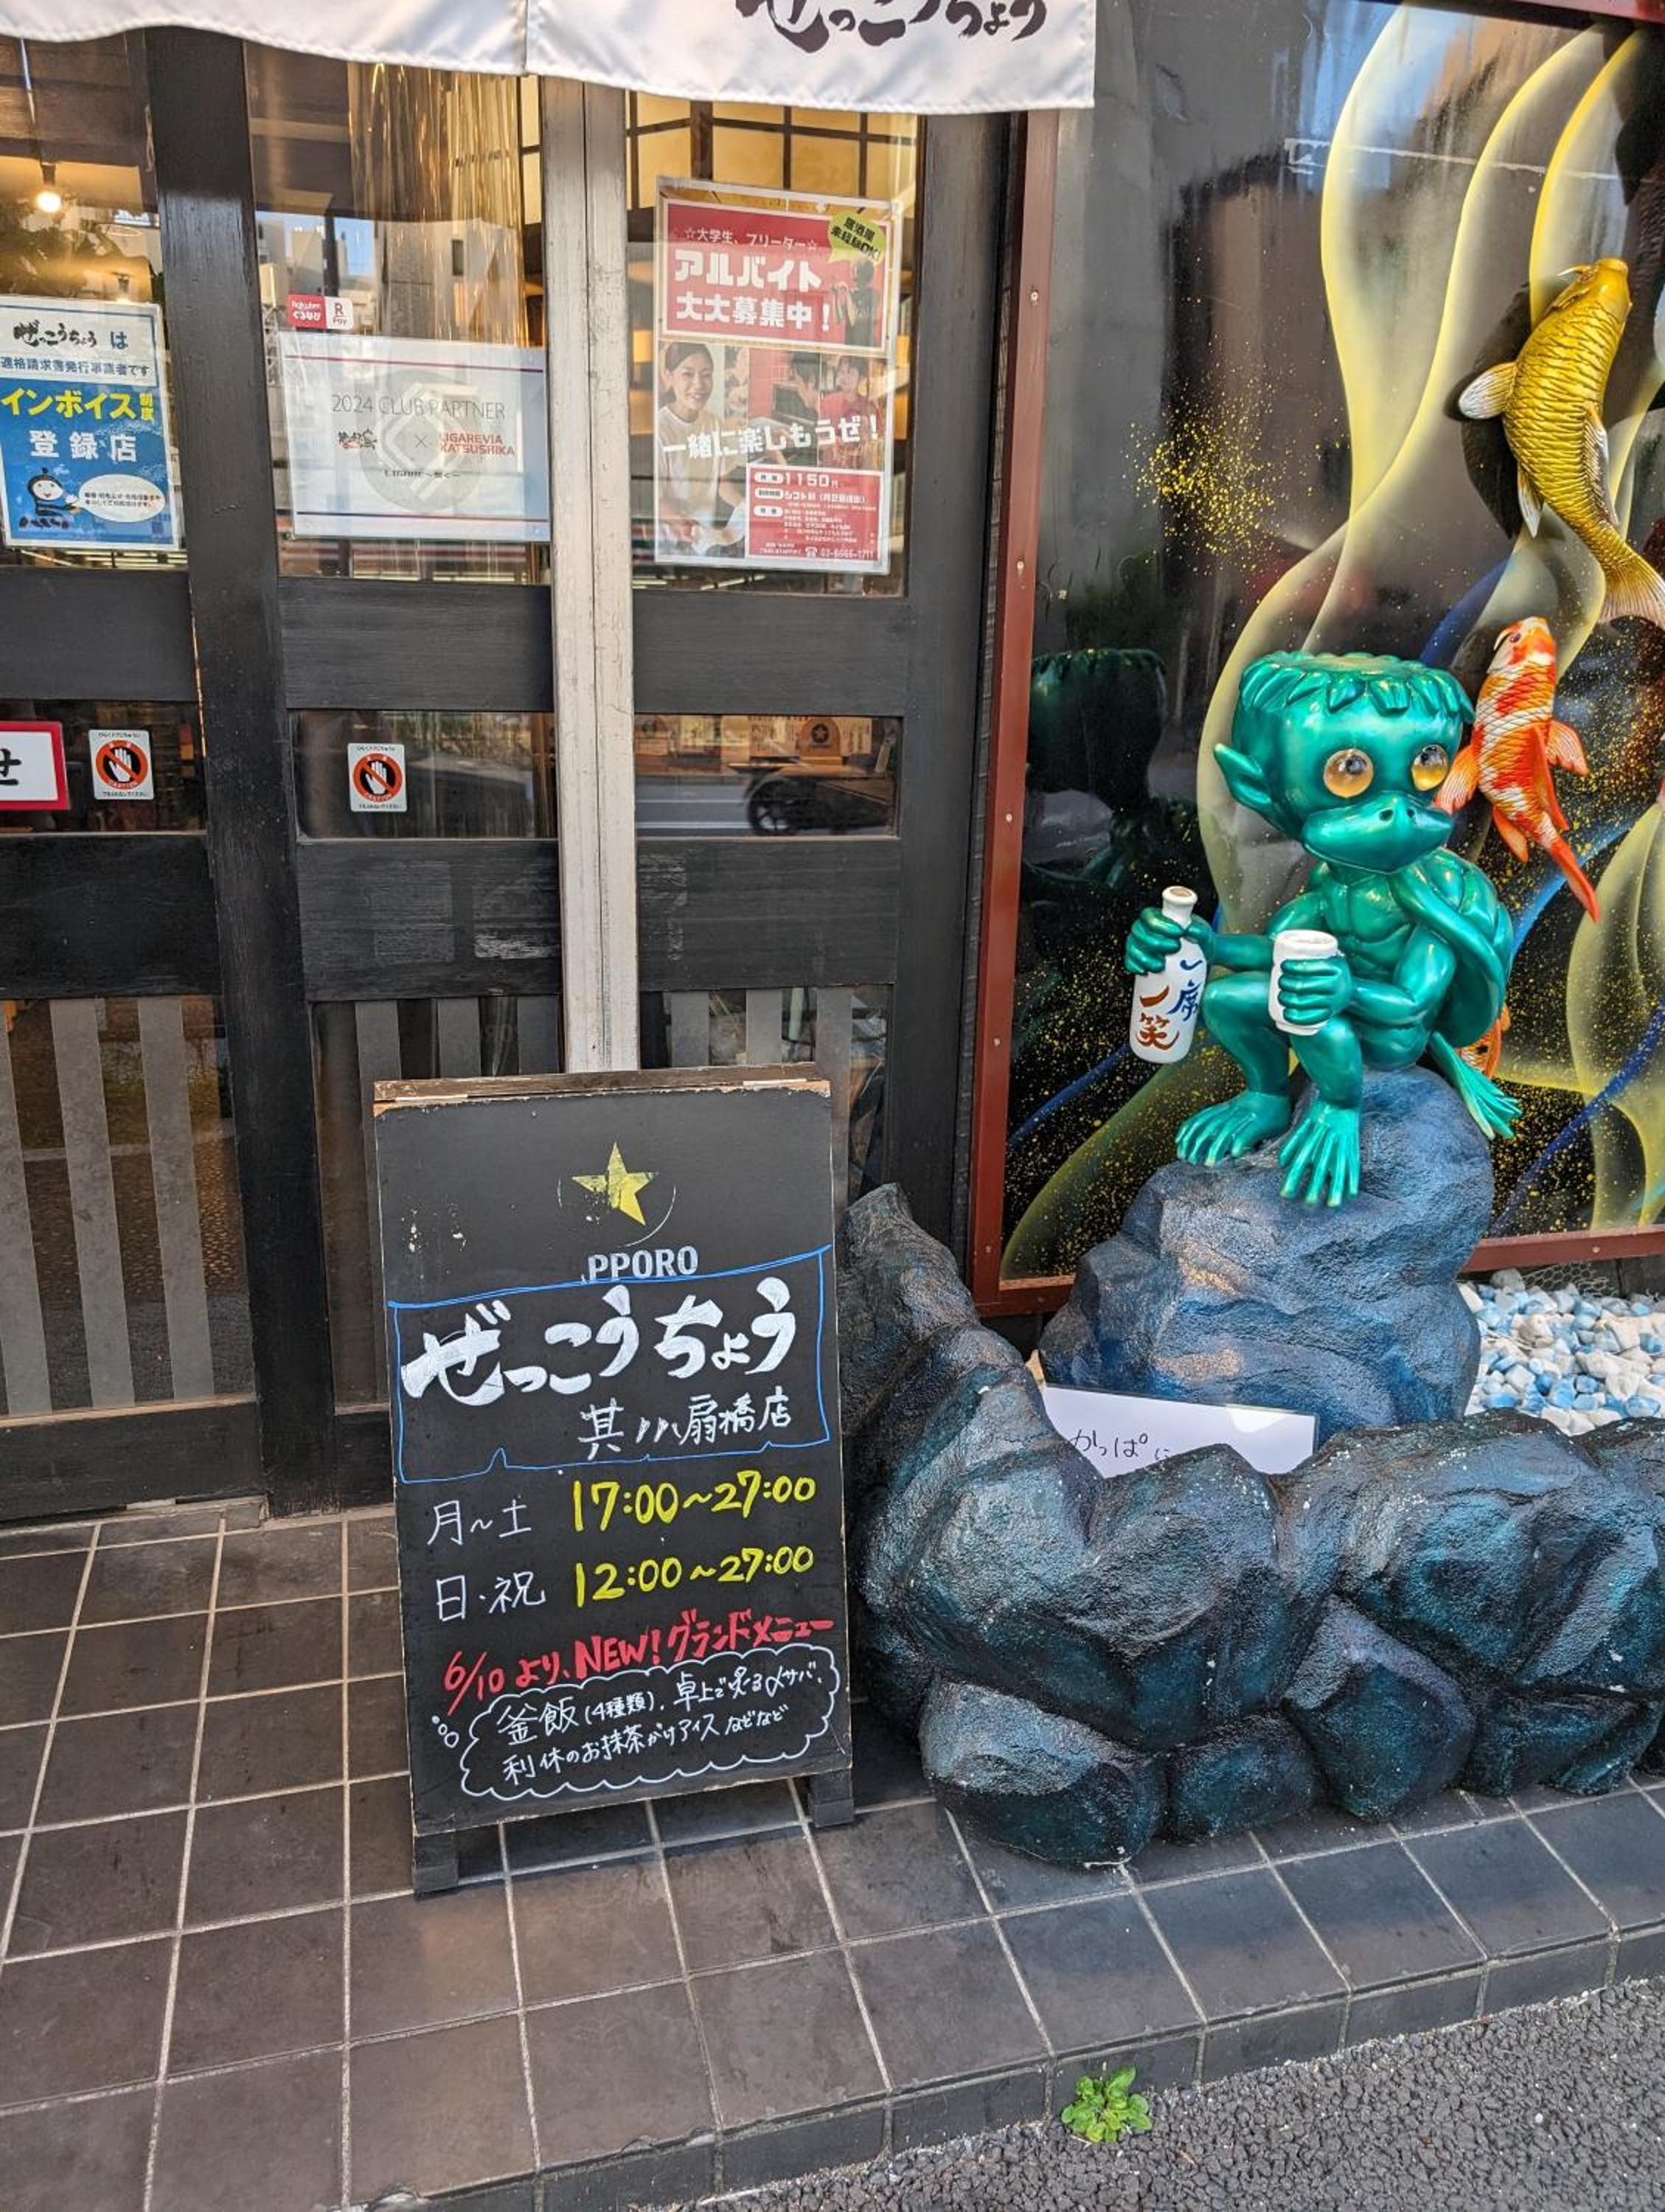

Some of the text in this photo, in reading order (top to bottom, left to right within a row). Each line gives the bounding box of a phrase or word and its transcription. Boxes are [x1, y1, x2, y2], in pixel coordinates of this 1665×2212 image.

[675, 249, 821, 293] アルバイト
[676, 292, 830, 331] 大大募集中！
[13, 319, 129, 349] ぜっこうちょう は
[0, 388, 137, 420] インボイス
[333, 395, 506, 420] 2024 CLUB PARTNER
[29, 430, 137, 462] 登録店
[440, 443, 515, 456] KATSUSHIKA
[663, 414, 879, 459] 一緒に楽しもうぜ！
[400, 1276, 796, 1406] ぜっこうちょう
[573, 1470, 816, 1533] 17:00~27:00
[574, 1545, 814, 1608] 12:00~27:00
